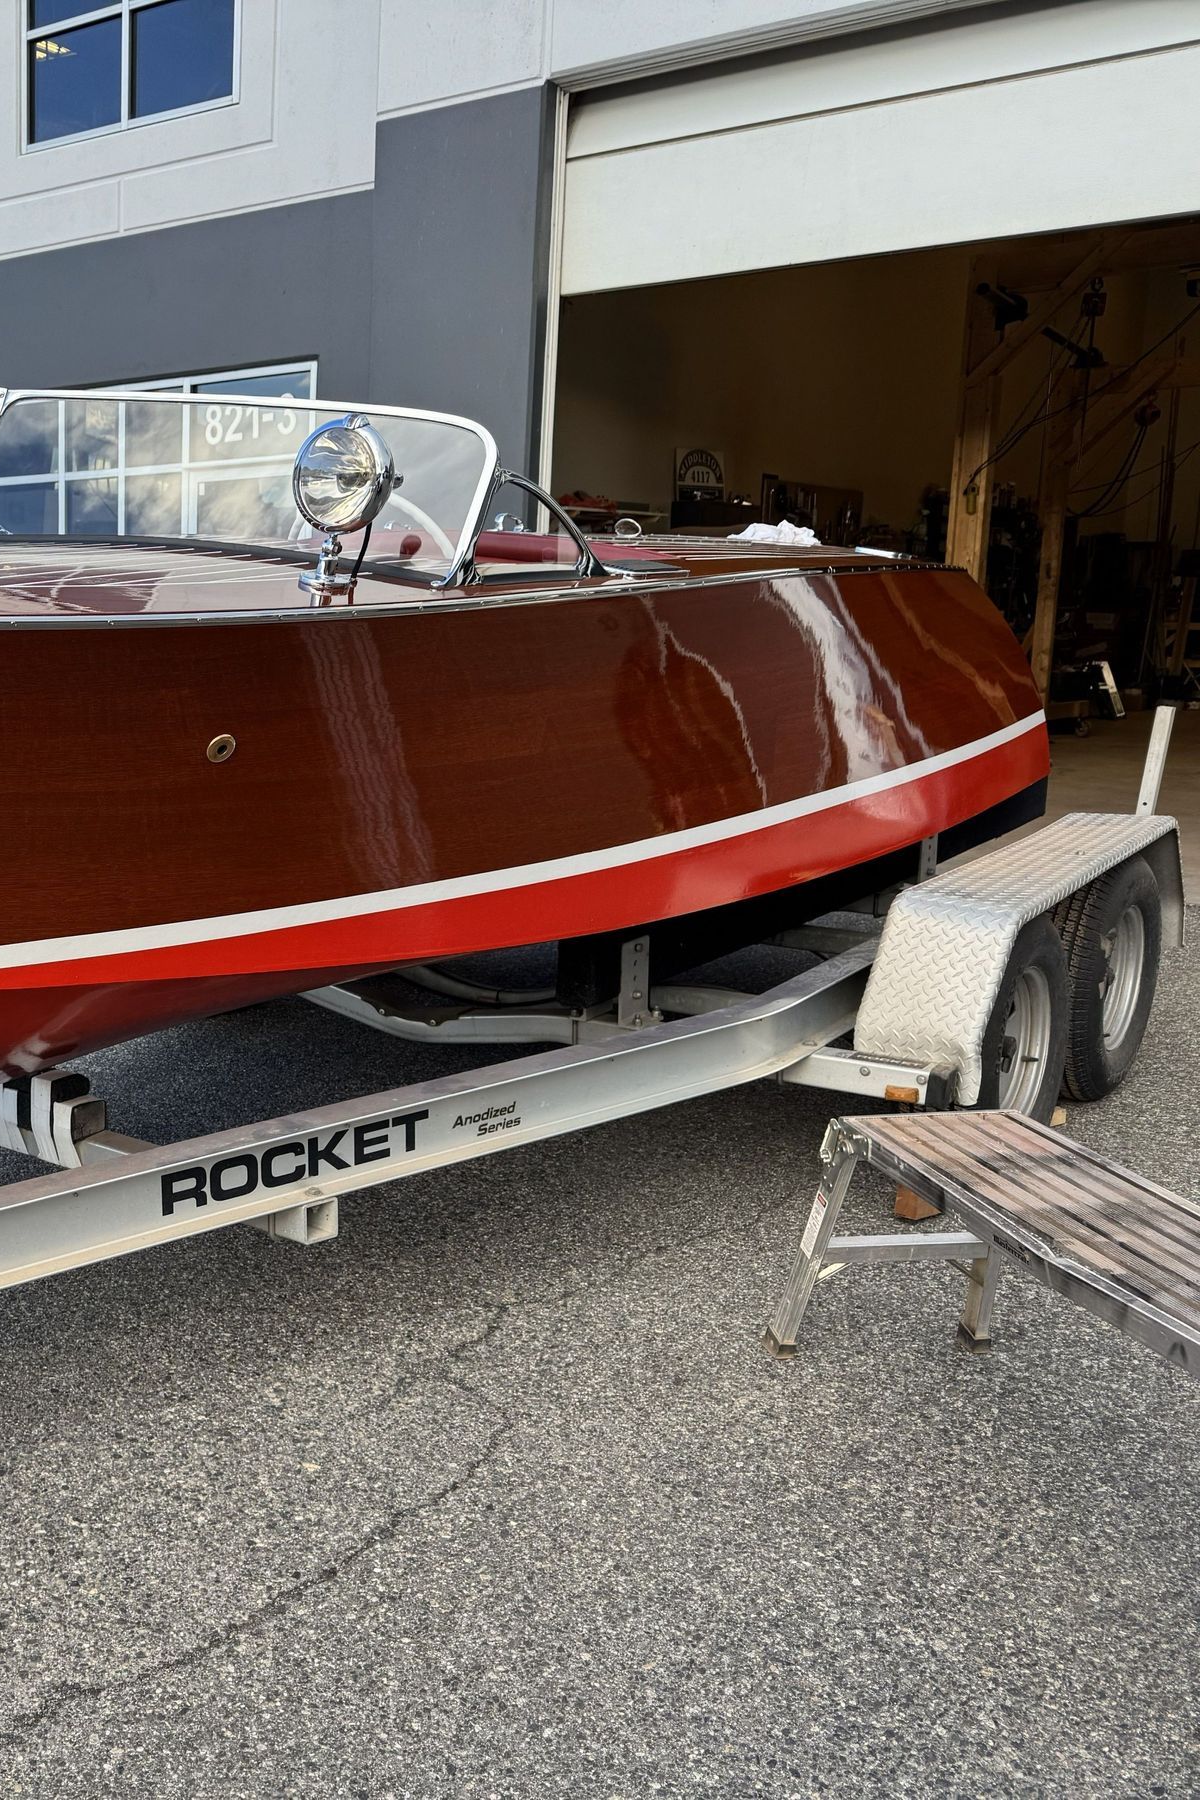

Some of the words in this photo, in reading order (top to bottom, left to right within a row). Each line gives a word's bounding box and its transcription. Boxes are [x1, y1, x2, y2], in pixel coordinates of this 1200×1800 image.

[205, 393, 297, 445] 821-3
[452, 1101, 516, 1129] Anodized
[477, 1116, 521, 1137] Series
[160, 1108, 429, 1217] ROCKET
